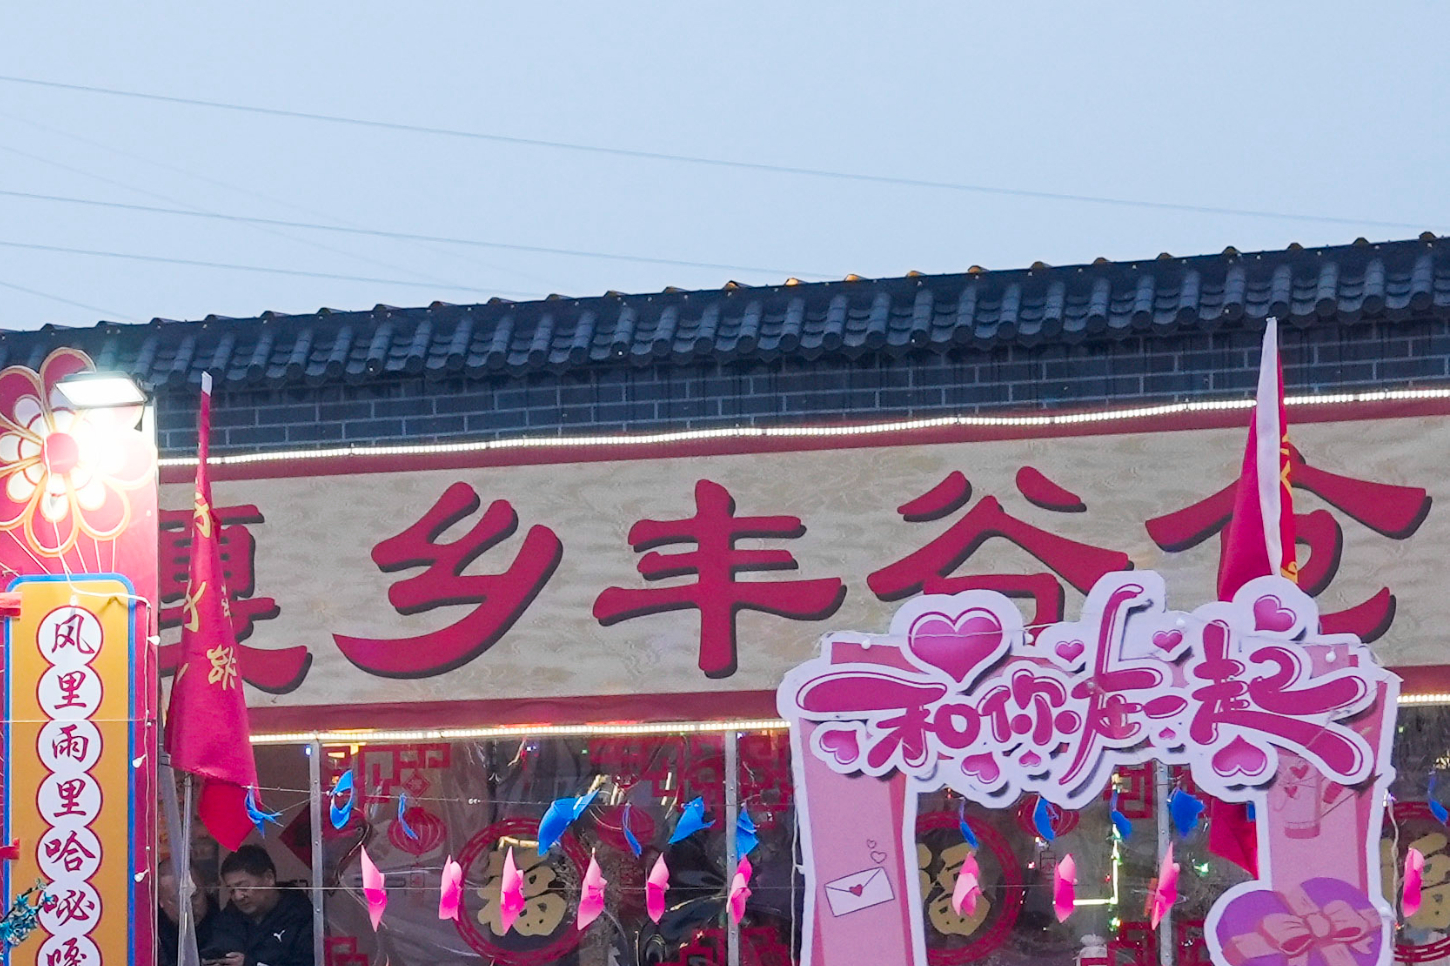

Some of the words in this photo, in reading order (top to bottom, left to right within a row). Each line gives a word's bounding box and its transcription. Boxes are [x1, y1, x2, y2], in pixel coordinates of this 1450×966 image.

[801, 582, 1368, 784] 和你在一起
